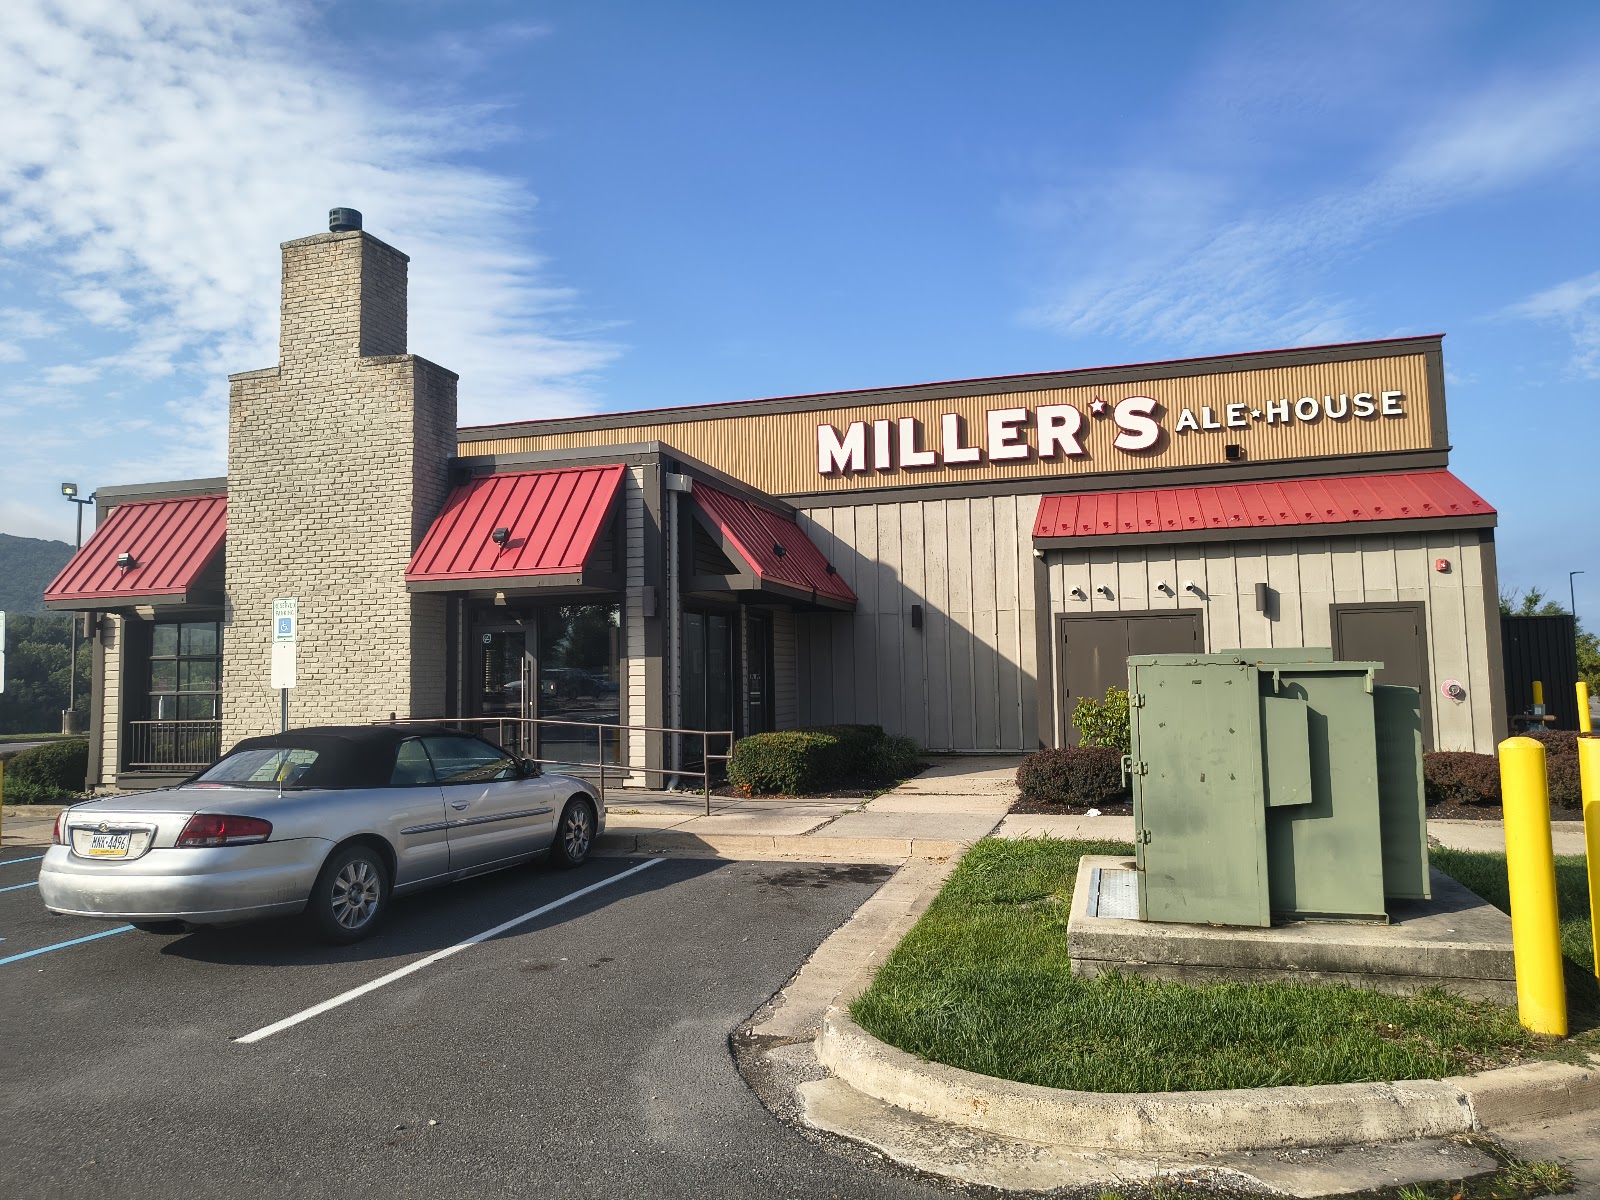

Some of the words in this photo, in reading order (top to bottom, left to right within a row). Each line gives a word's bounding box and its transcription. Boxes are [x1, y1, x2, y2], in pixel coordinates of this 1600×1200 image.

[816, 396, 1160, 475] MILLER'S
[1175, 402, 1247, 433] ALE
[1266, 390, 1403, 424] HOUSE
